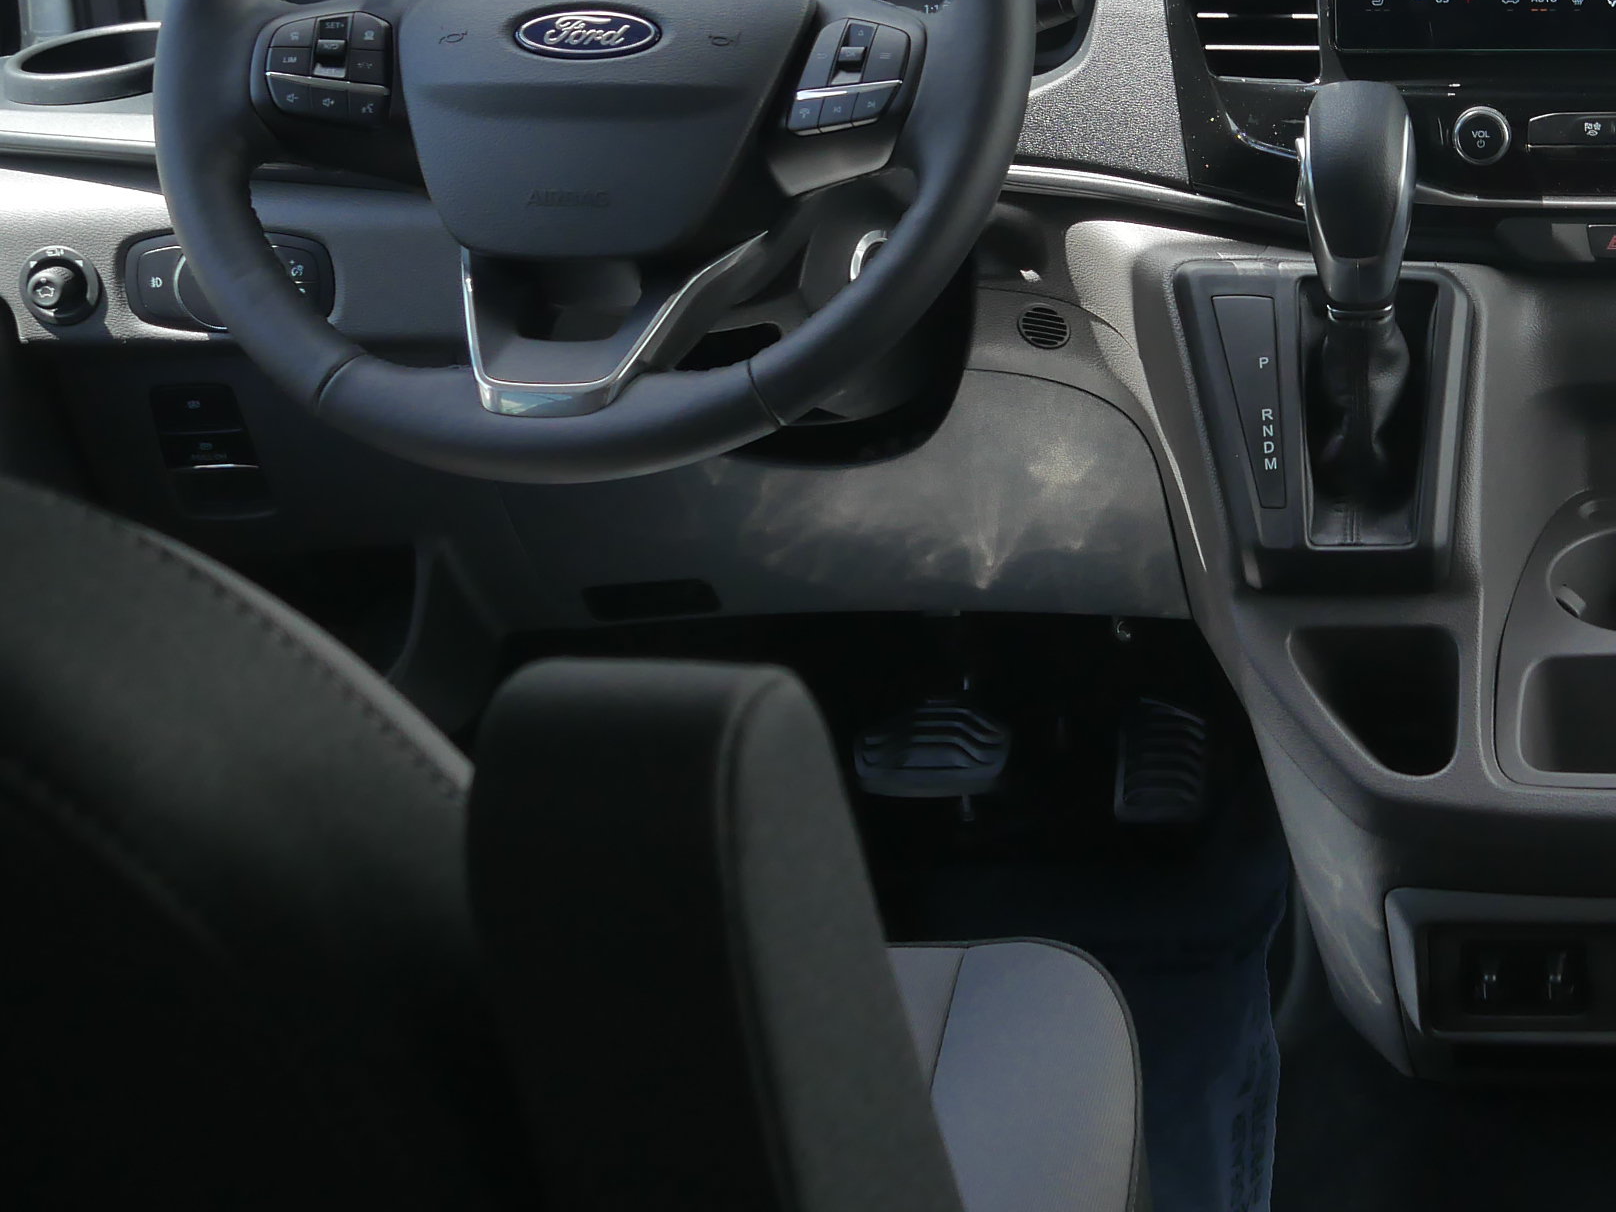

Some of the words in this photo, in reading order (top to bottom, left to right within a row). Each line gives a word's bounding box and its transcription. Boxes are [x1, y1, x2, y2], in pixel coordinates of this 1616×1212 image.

[544, 15, 630, 46] Ford
[1471, 130, 1491, 138] VOL
[1259, 356, 1270, 369] P
[1261, 408, 1274, 421] R
[1262, 425, 1274, 437] N
[1263, 441, 1275, 454] D
[1264, 458, 1277, 470] M
